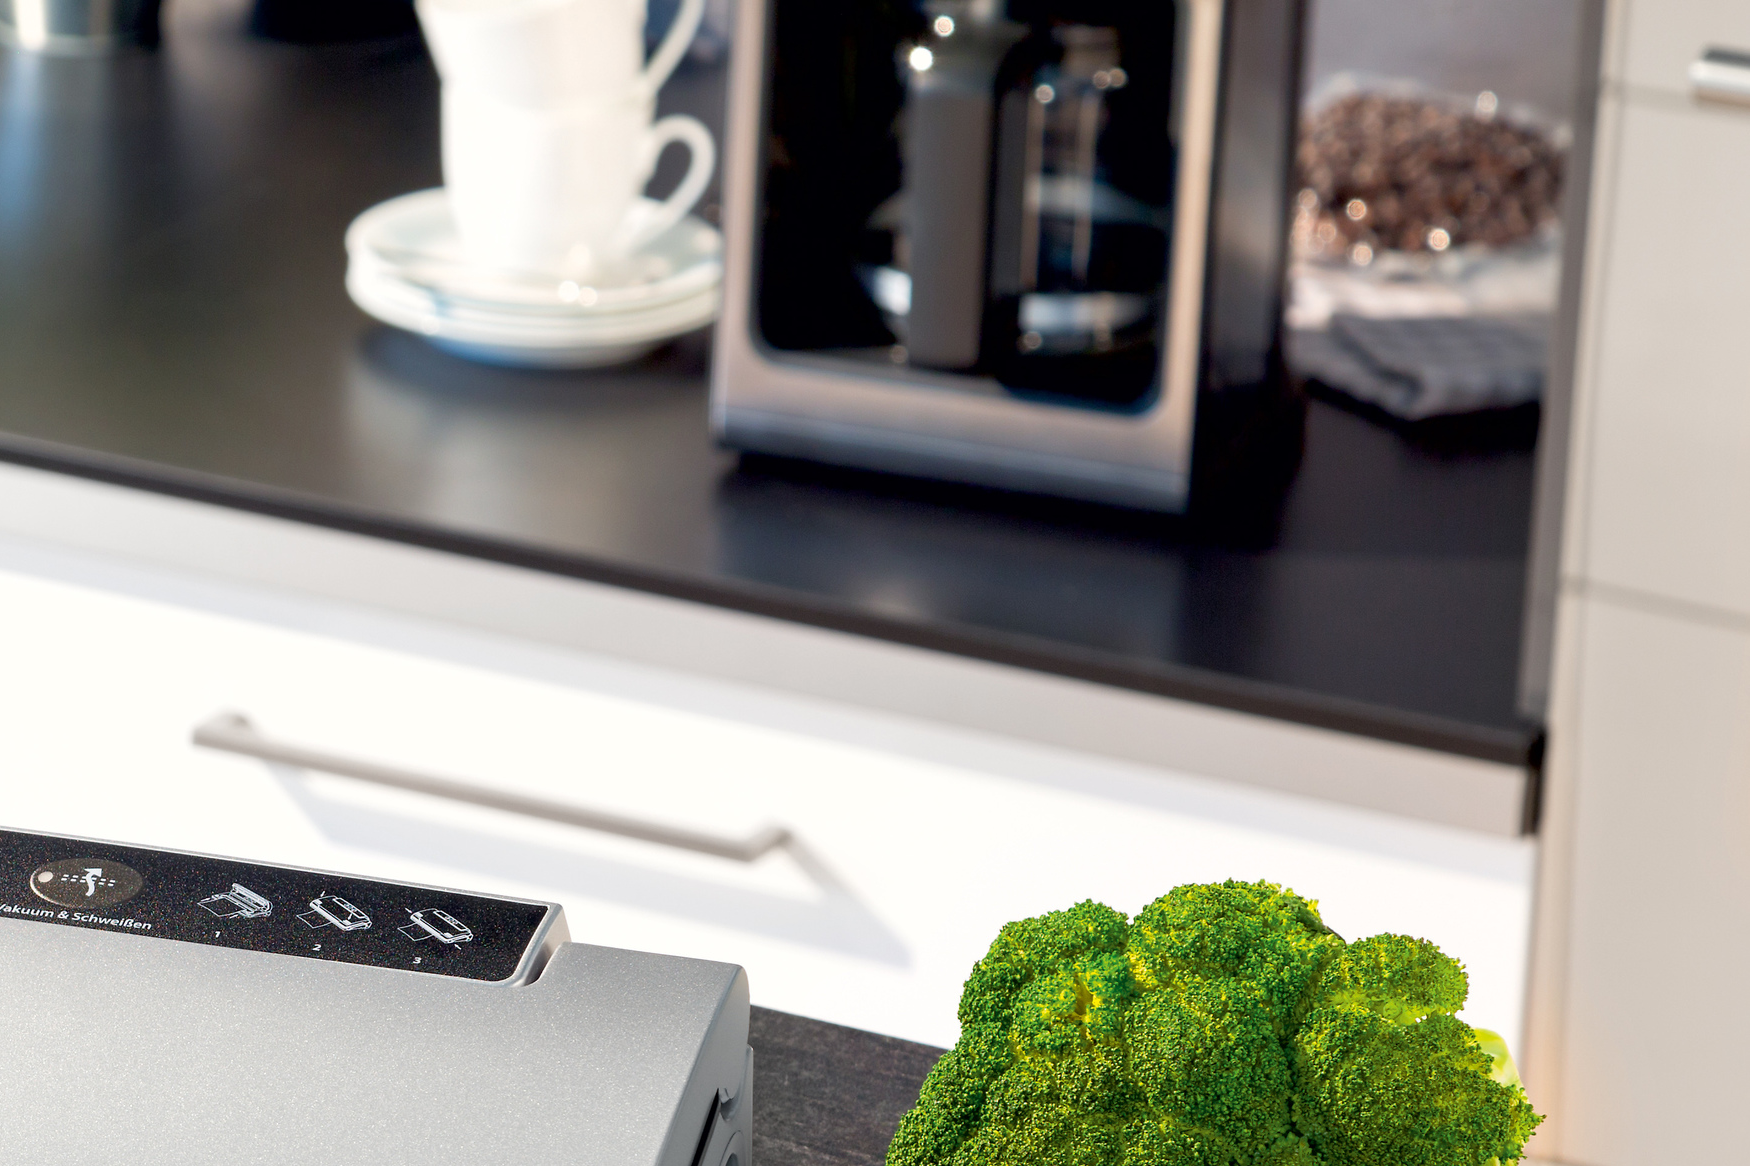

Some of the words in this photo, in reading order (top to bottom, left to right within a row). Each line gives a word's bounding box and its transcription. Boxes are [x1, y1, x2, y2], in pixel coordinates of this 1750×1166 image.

[57, 910, 69, 920] &
[72, 912, 152, 931] Schweißen
[413, 957, 422, 965] 3
